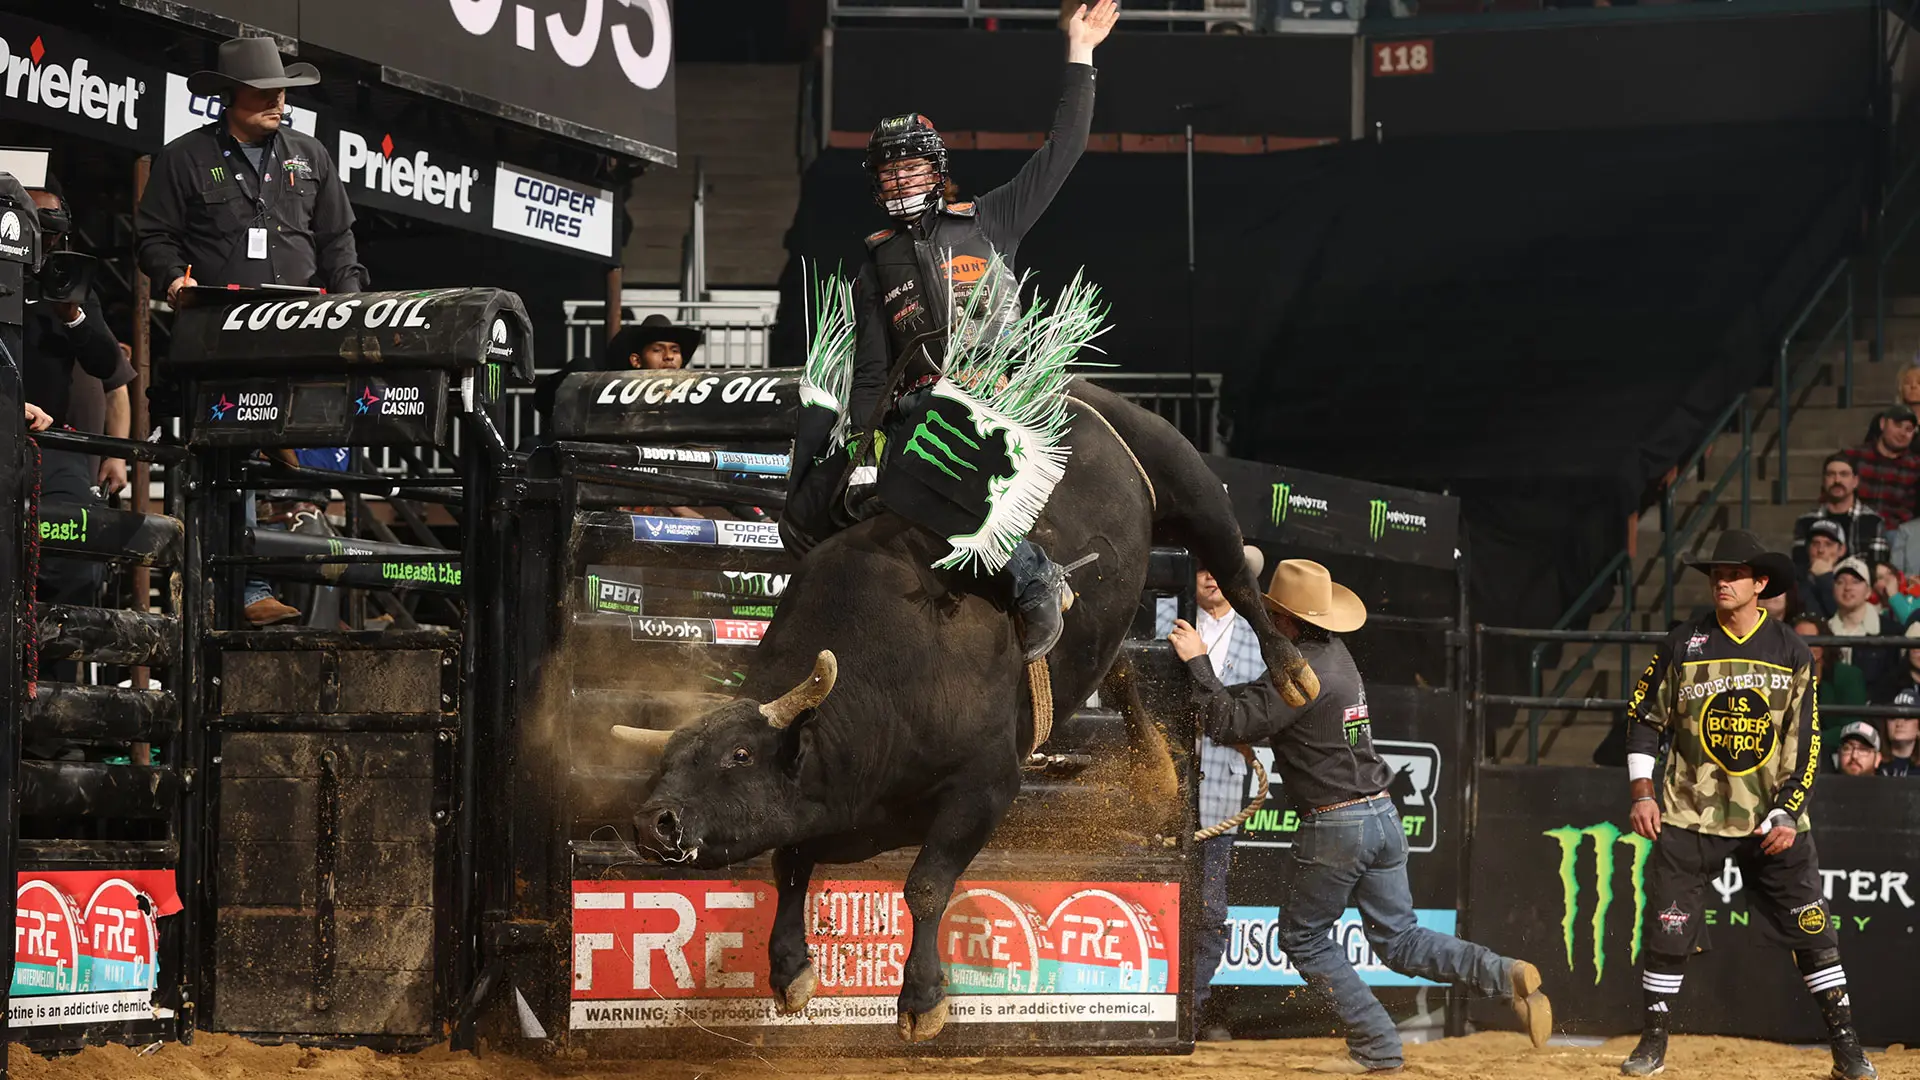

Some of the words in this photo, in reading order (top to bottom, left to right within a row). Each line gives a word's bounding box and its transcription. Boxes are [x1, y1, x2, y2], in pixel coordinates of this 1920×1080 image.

[1378, 45, 1428, 72] 118
[514, 177, 595, 216] COOPER
[525, 206, 582, 238] TIRES
[222, 299, 362, 331] LUCAS
[363, 298, 432, 329] OIL
[238, 393, 273, 406] MODO
[384, 387, 419, 401] MODO
[597, 377, 720, 404] LUCAS
[722, 377, 781, 403] OIL
[237, 406, 279, 421] CASINO
[381, 401, 425, 415] CASINO
[643, 447, 677, 461] BOOT
[677, 450, 711, 464] BARN
[1289, 495, 1328, 511] MONSTER
[39, 508, 88, 543] east!
[724, 523, 778, 534] COOPE
[1387, 511, 1427, 527] MONSTER
[733, 533, 779, 544] TIRES
[438, 562, 462, 586] the
[639, 619, 702, 639] Kubota
[725, 621, 760, 639] FRE
[1678, 673, 1767, 702] PROTECTED
[1771, 674, 1793, 690] BY
[1728, 697, 1751, 713] U.S.
[1709, 717, 1768, 735] BORDER
[1711, 734, 1765, 753] PATROL
[1801, 735, 1821, 789] BORDER
[804, 891, 904, 936] ICOTINE
[16, 908, 62, 958] FRE
[94, 906, 141, 954] FRE
[573, 892, 755, 990] FRE
[948, 914, 1016, 961] FRE
[1062, 913, 1128, 960] FRE
[16, 968, 55, 989] WATERMELON
[56, 959, 67, 991] 15
[105, 964, 125, 983] MINT
[133, 955, 144, 987] 12
[952, 968, 1005, 989] WATERMELON
[1006, 961, 1021, 991] 15
[1077, 969, 1105, 986] MINT
[1118, 961, 1133, 991] 12
[36, 1004, 46, 1018] is
[49, 1006, 61, 1017] an
[64, 1001, 109, 1017] addictive
[586, 1007, 668, 1021] WARNING:
[674, 1006, 708, 1020] This
[711, 1006, 771, 1021] product
[981, 1002, 993, 1015] is
[998, 1005, 1015, 1015] an
[1020, 1002, 1083, 1015] addictive
[1089, 1001, 1155, 1015] chemical.
